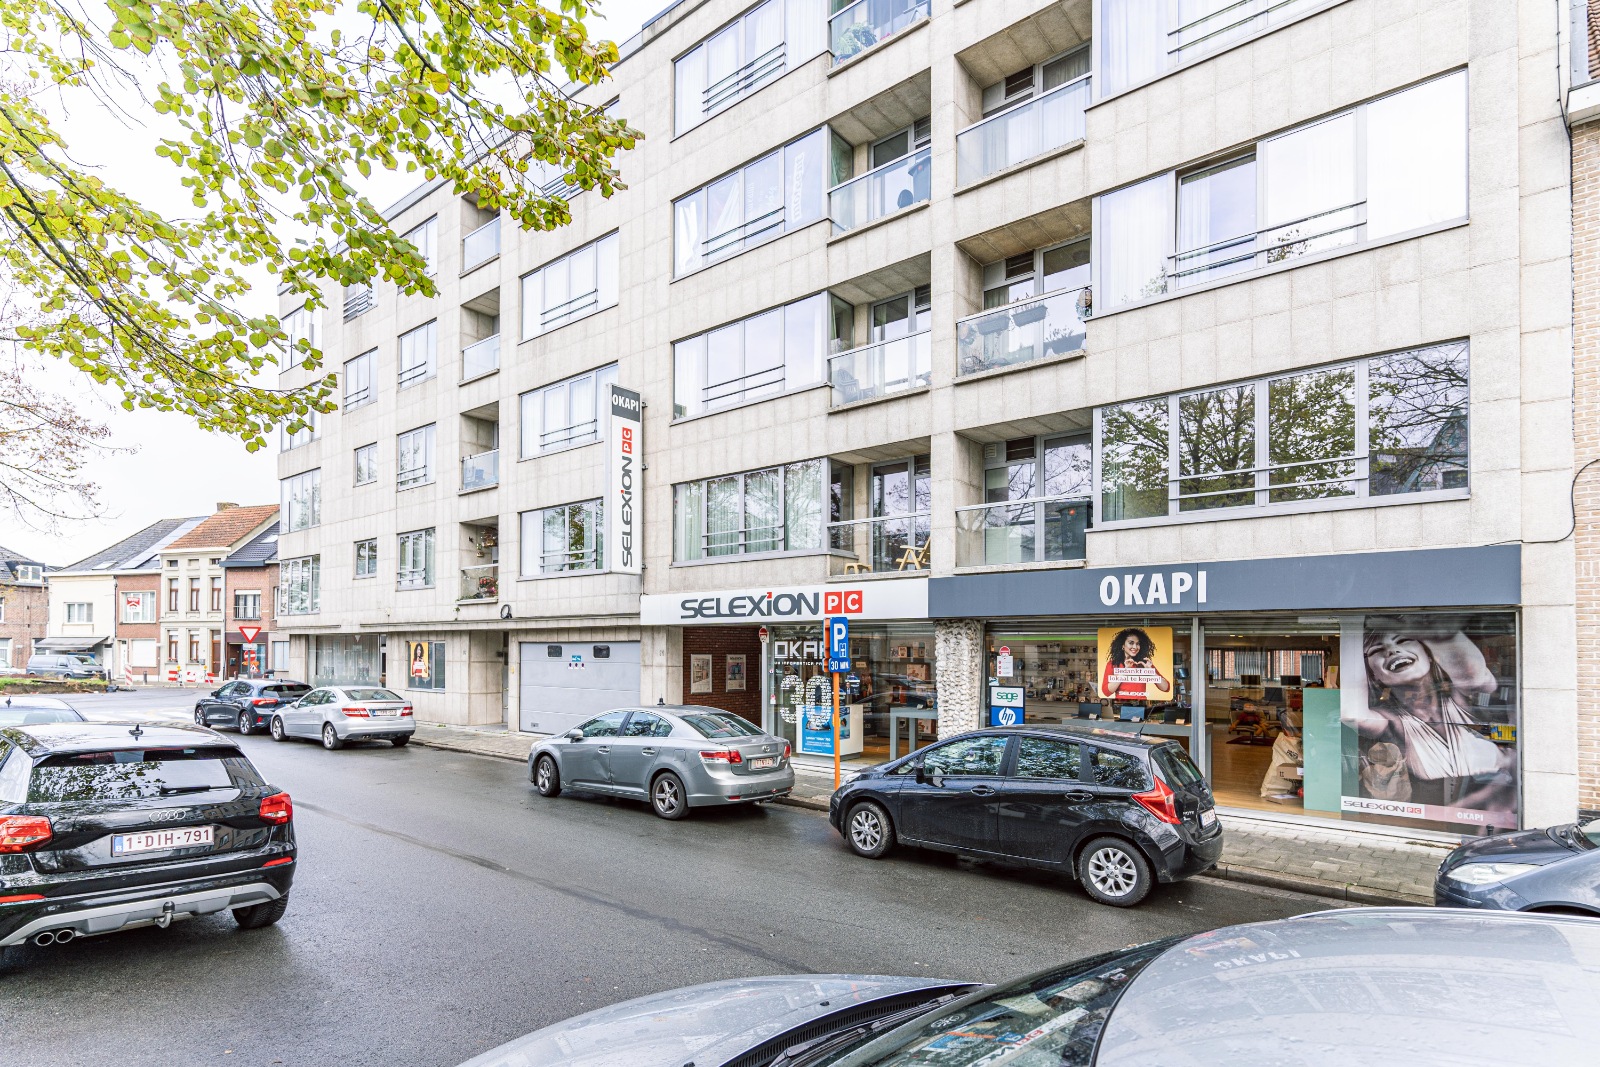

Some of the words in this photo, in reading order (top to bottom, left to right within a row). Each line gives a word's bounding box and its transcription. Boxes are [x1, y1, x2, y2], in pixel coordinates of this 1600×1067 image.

[612, 393, 639, 412] OKAPI
[623, 428, 632, 453] PC
[1099, 570, 1207, 606] OKAPI
[826, 592, 861, 612] PC
[833, 623, 846, 652] P
[774, 640, 825, 659] OKA
[830, 660, 839, 670] 30
[996, 692, 1018, 702] sage
[1001, 708, 1014, 725] hp
[1456, 811, 1484, 822] OKAPI
[126, 829, 209, 850] 1-DIH-791
